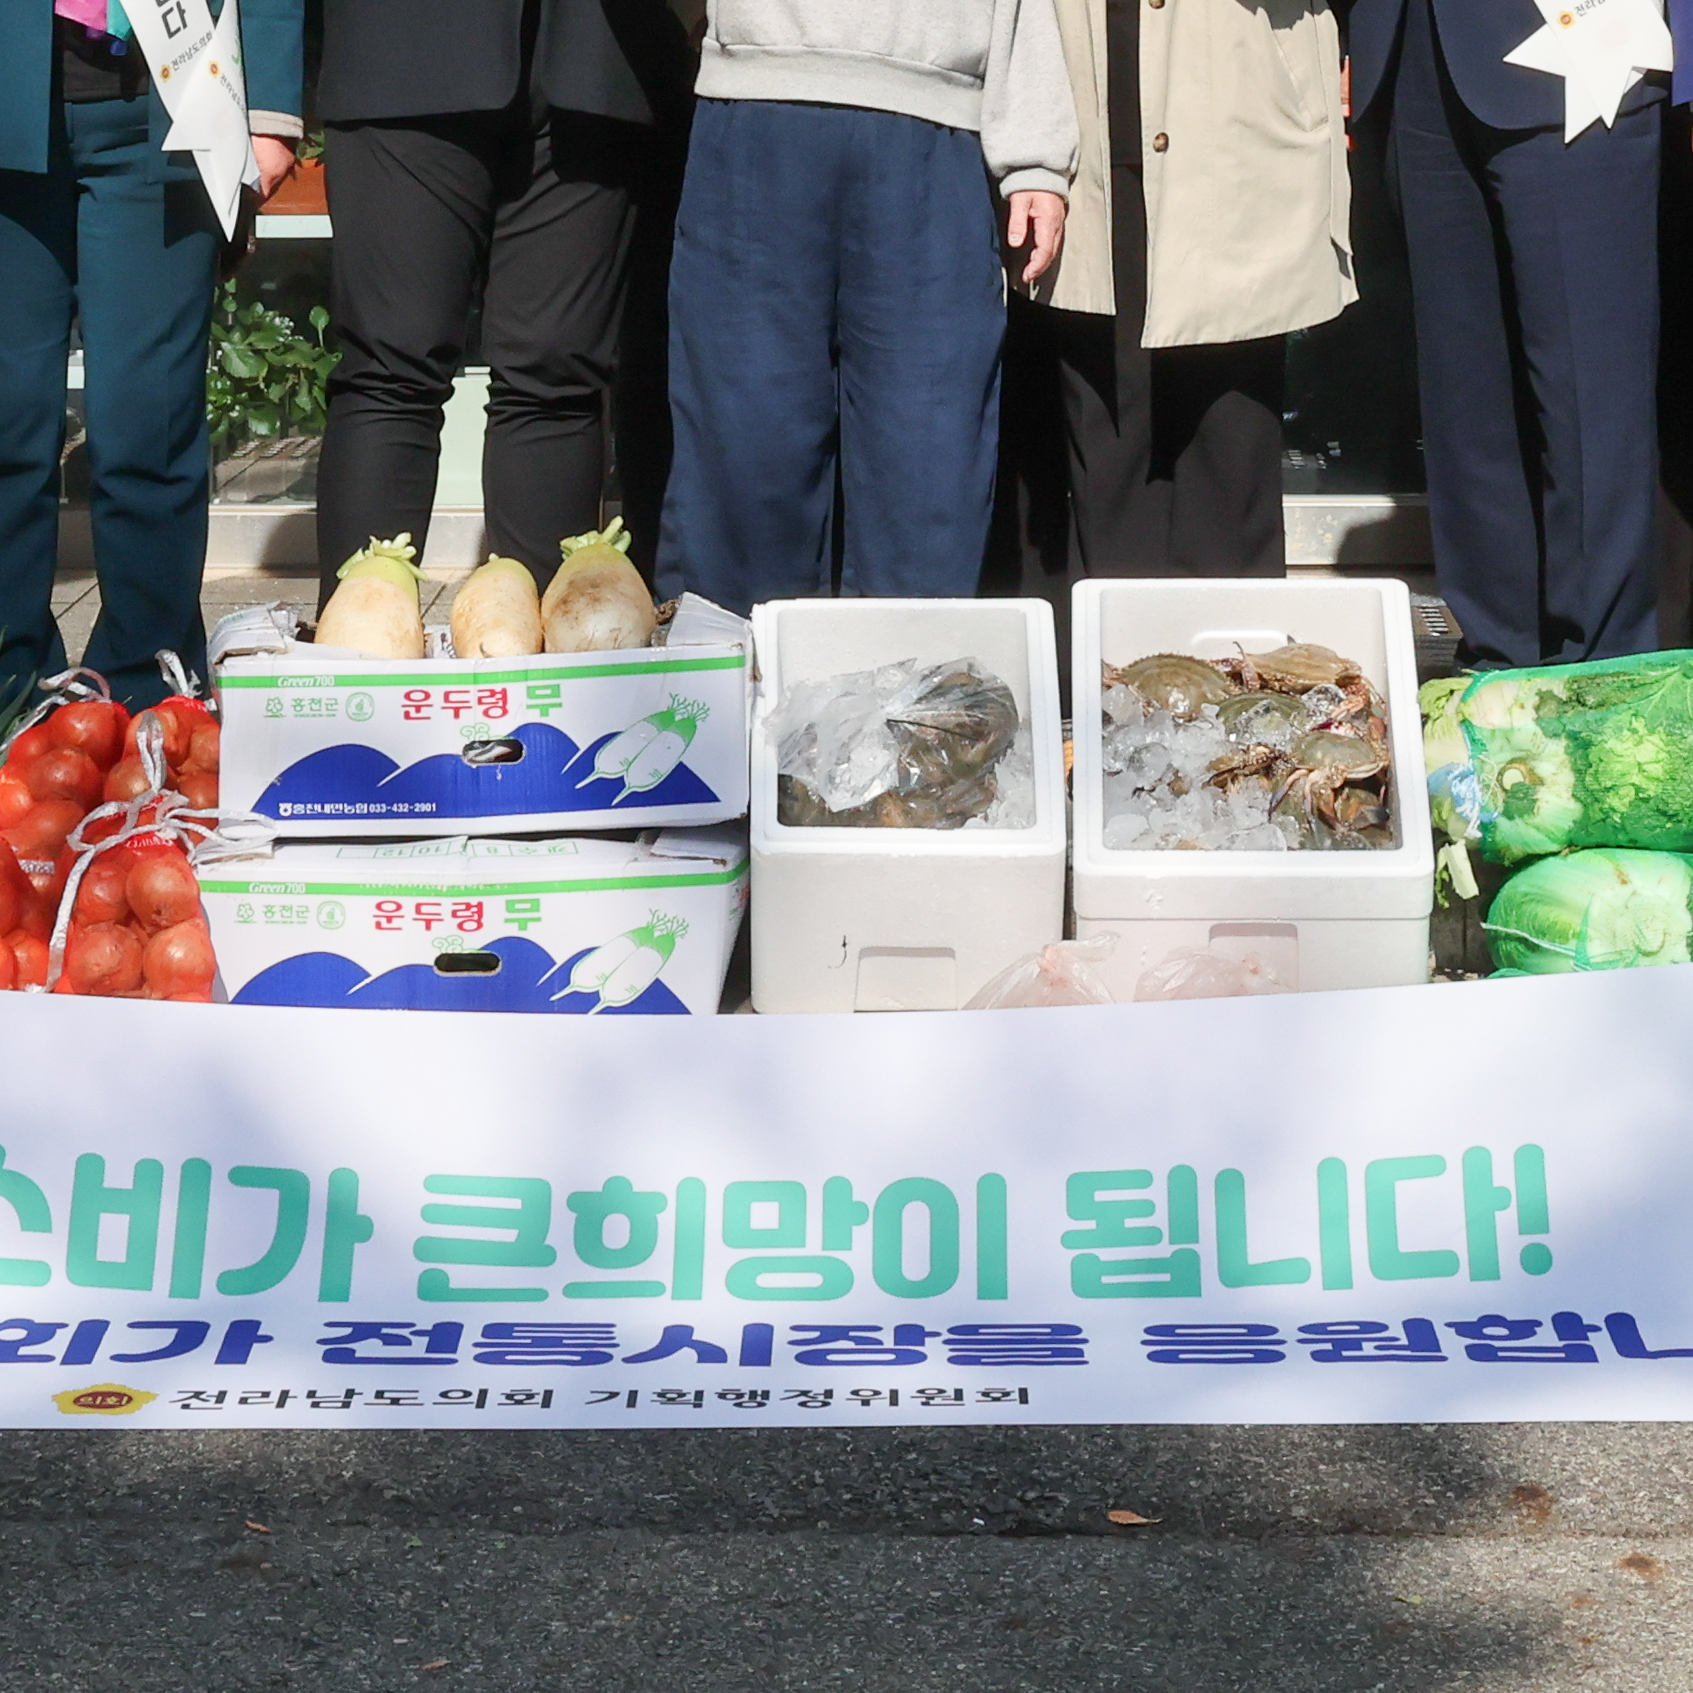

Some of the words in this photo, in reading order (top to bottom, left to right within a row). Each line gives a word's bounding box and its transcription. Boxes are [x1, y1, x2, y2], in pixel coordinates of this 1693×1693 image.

[291, 697, 339, 713] 홍천군
[402, 688, 509, 720] 운두령
[527, 684, 563, 718] 무
[263, 904, 310, 919] 홍천군
[373, 901, 484, 932] 운두령
[504, 898, 542, 931] 무
[1060, 1143, 1553, 1299] 됩니다!
[316, 1320, 1090, 1367] 전통시장을
[75, 1392, 130, 1409] 의회
[168, 1387, 554, 1411] 전라남도의회
[584, 1386, 1031, 1410] 기획행정위원회
